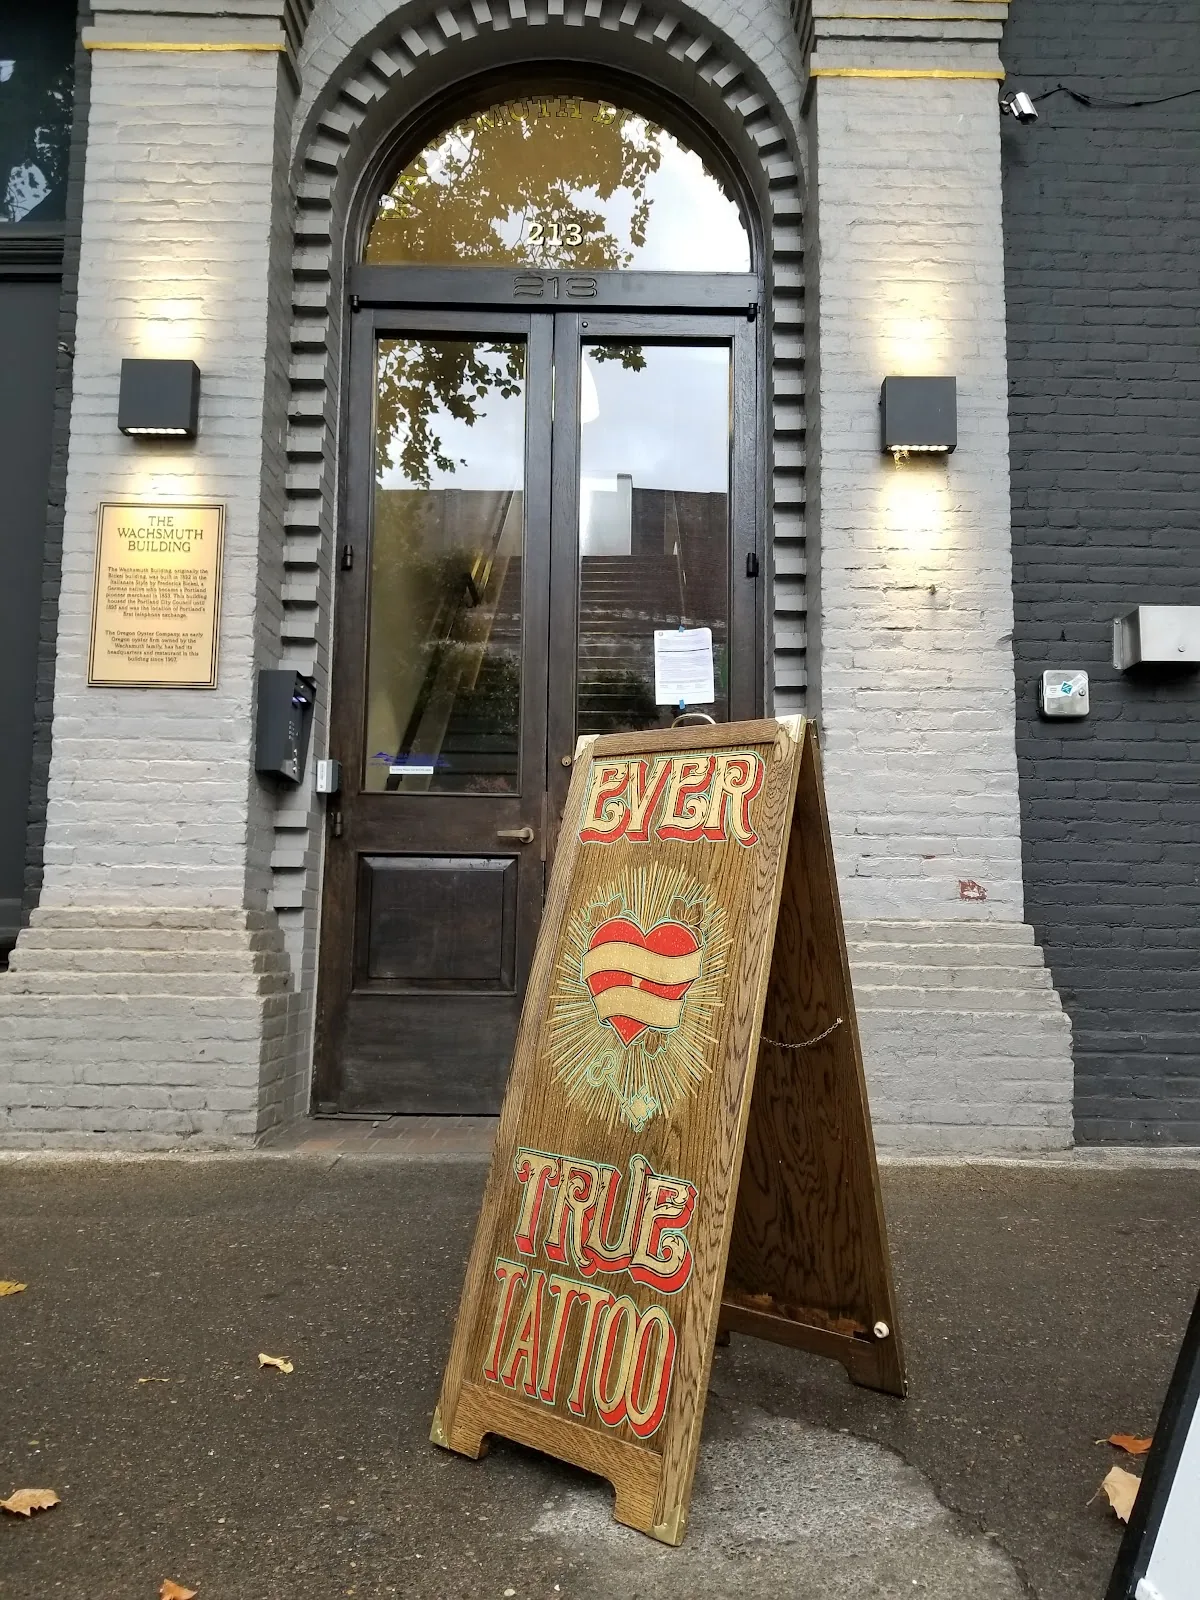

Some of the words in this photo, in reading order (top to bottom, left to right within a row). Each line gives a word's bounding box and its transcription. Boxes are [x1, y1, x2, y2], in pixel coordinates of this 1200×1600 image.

[527, 223, 584, 246] 213
[513, 276, 598, 299] 213
[148, 516, 174, 527] THE
[117, 528, 204, 540] WACHSMUTH
[128, 541, 191, 552] BUILDING
[579, 751, 766, 848] EVER
[514, 1147, 698, 1294] TRUE
[484, 1257, 677, 1439] TATTOO
